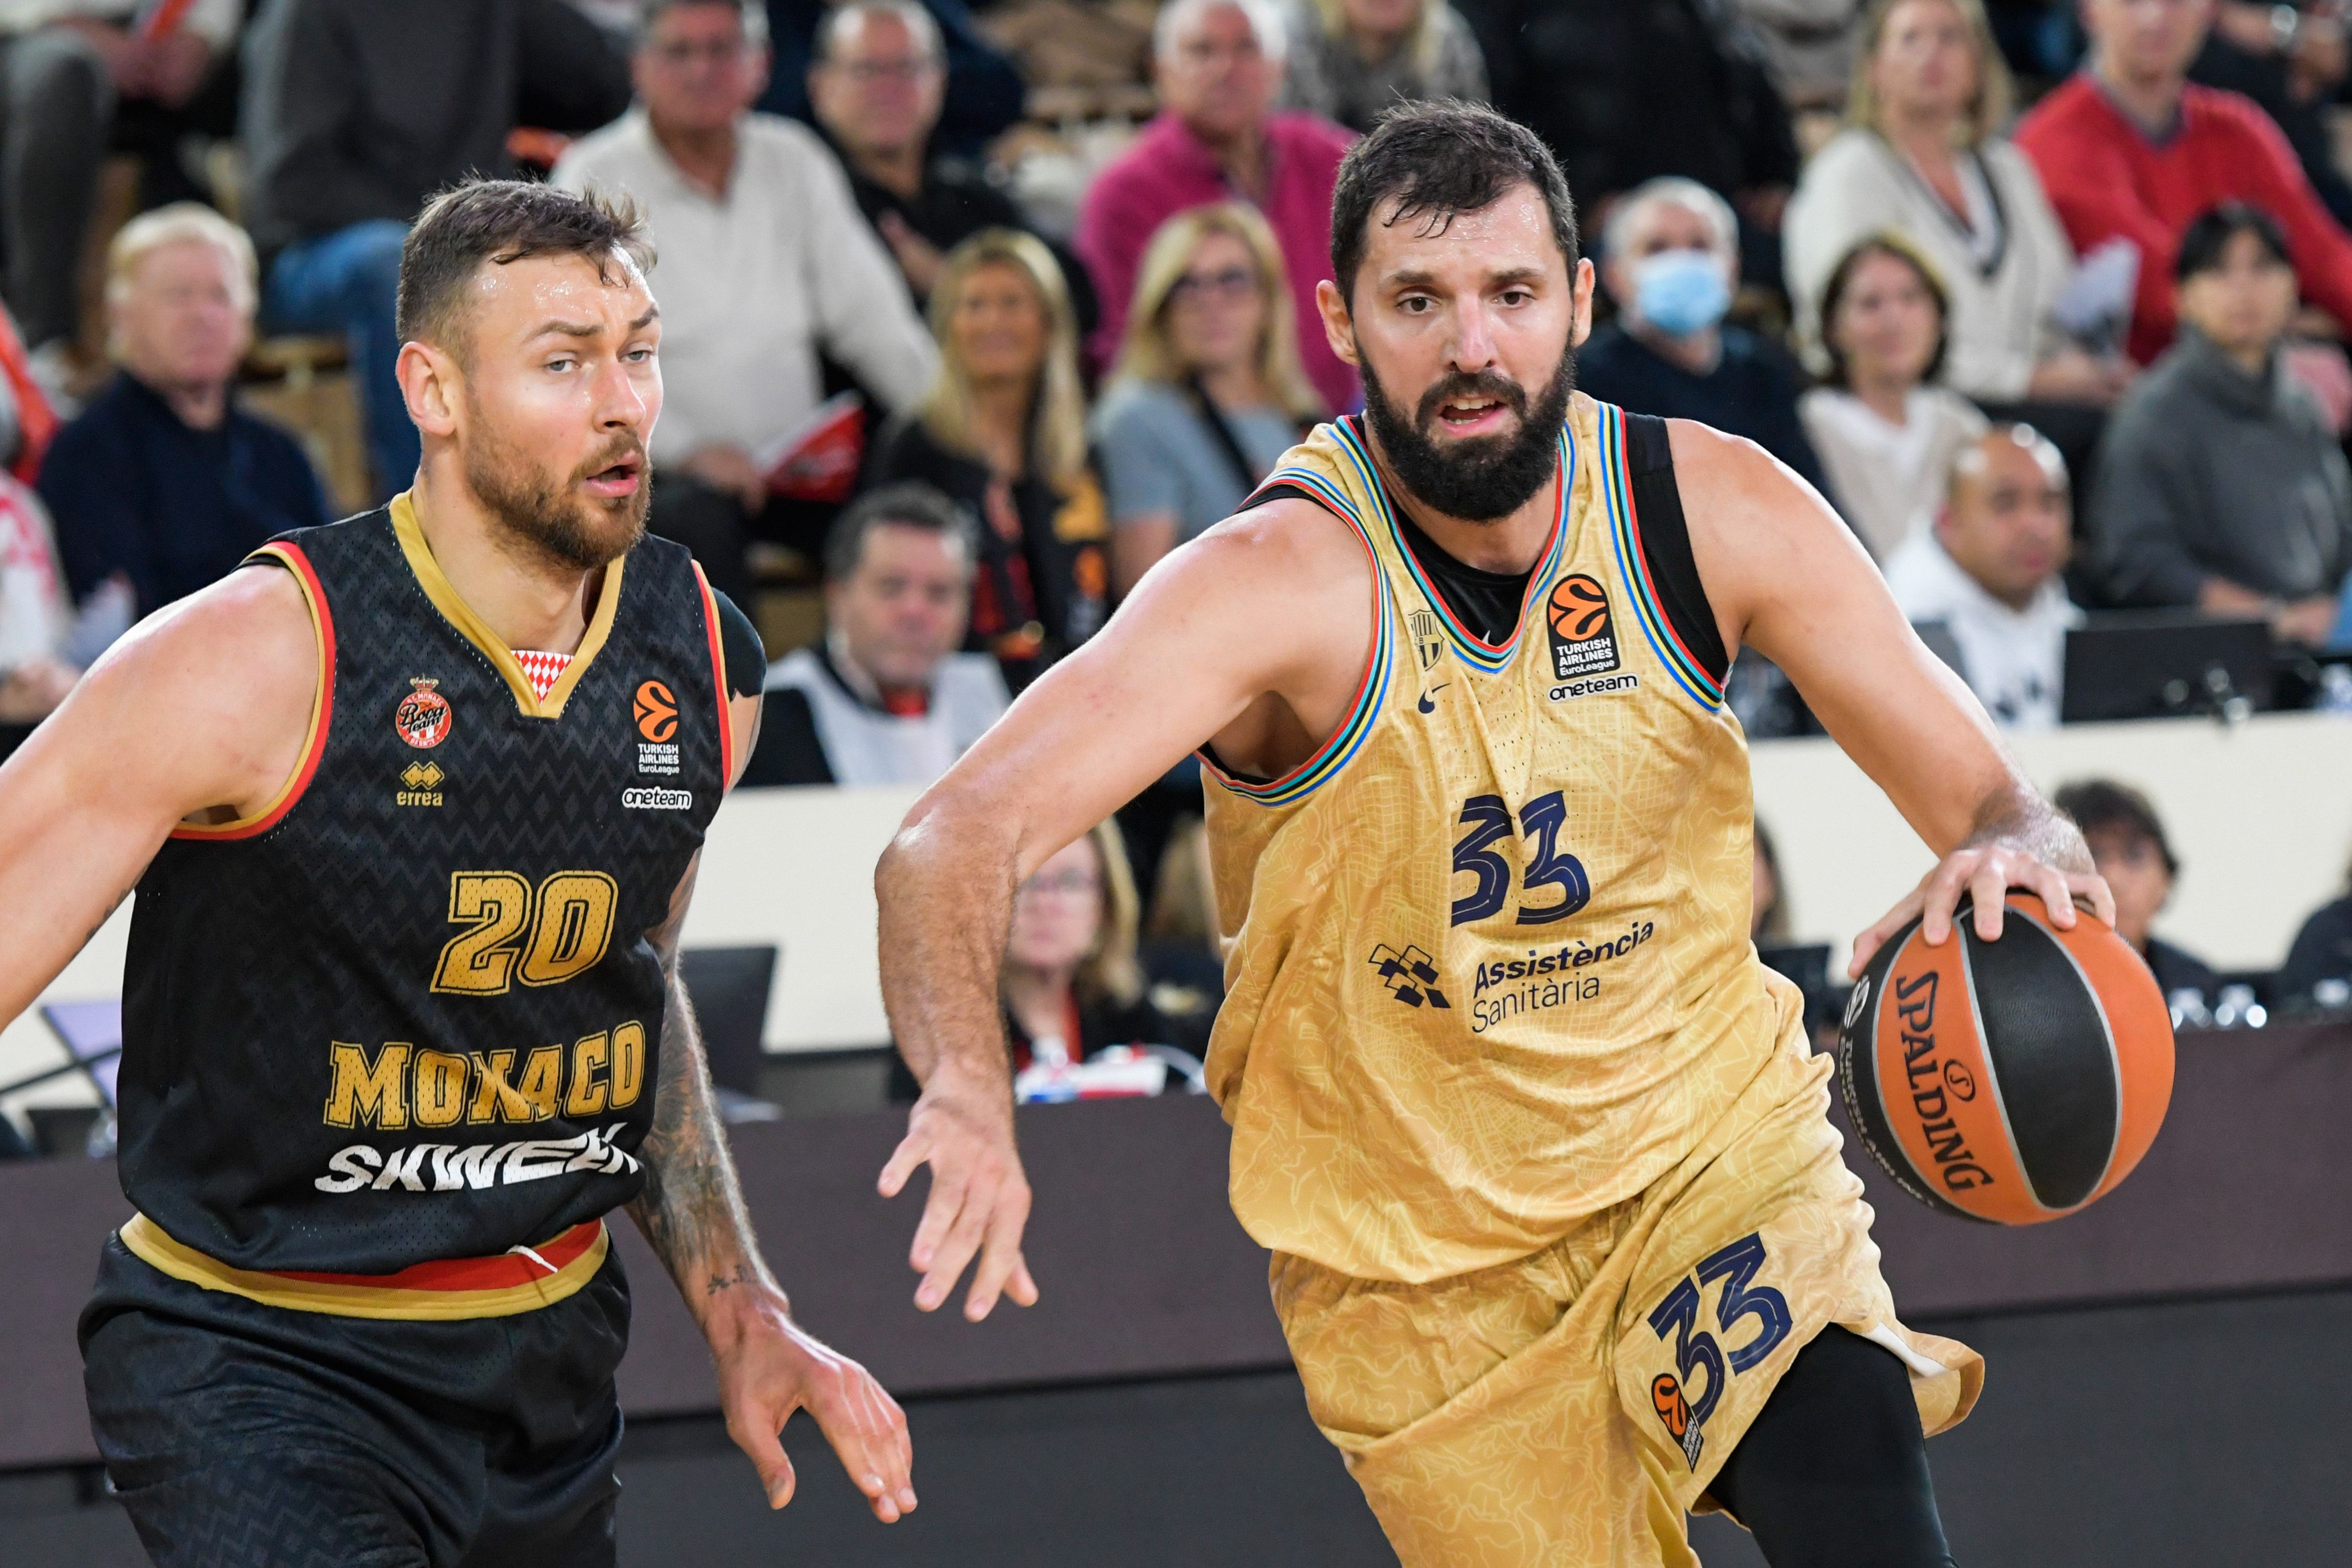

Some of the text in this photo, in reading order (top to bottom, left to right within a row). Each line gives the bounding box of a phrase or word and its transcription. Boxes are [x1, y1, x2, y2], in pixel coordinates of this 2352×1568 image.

[1557, 637, 1612, 656] TURKISH
[1559, 648, 1613, 667] AIRLINES
[1559, 660, 1615, 676] EuroLeague
[1550, 676, 1637, 700] oneteam
[638, 743, 679, 754] TURKISH
[639, 754, 679, 764] AIRLINES
[639, 764, 680, 775] EuroLeague
[397, 791, 443, 806] errea
[624, 790, 690, 806] oneteam
[1451, 790, 1591, 928] 33
[430, 870, 619, 996] 20
[1473, 921, 1654, 999] Assistència
[1472, 972, 1600, 1033] Sanitària
[1895, 970, 1994, 1193] SPALDING
[1647, 1231, 1793, 1428] 33
